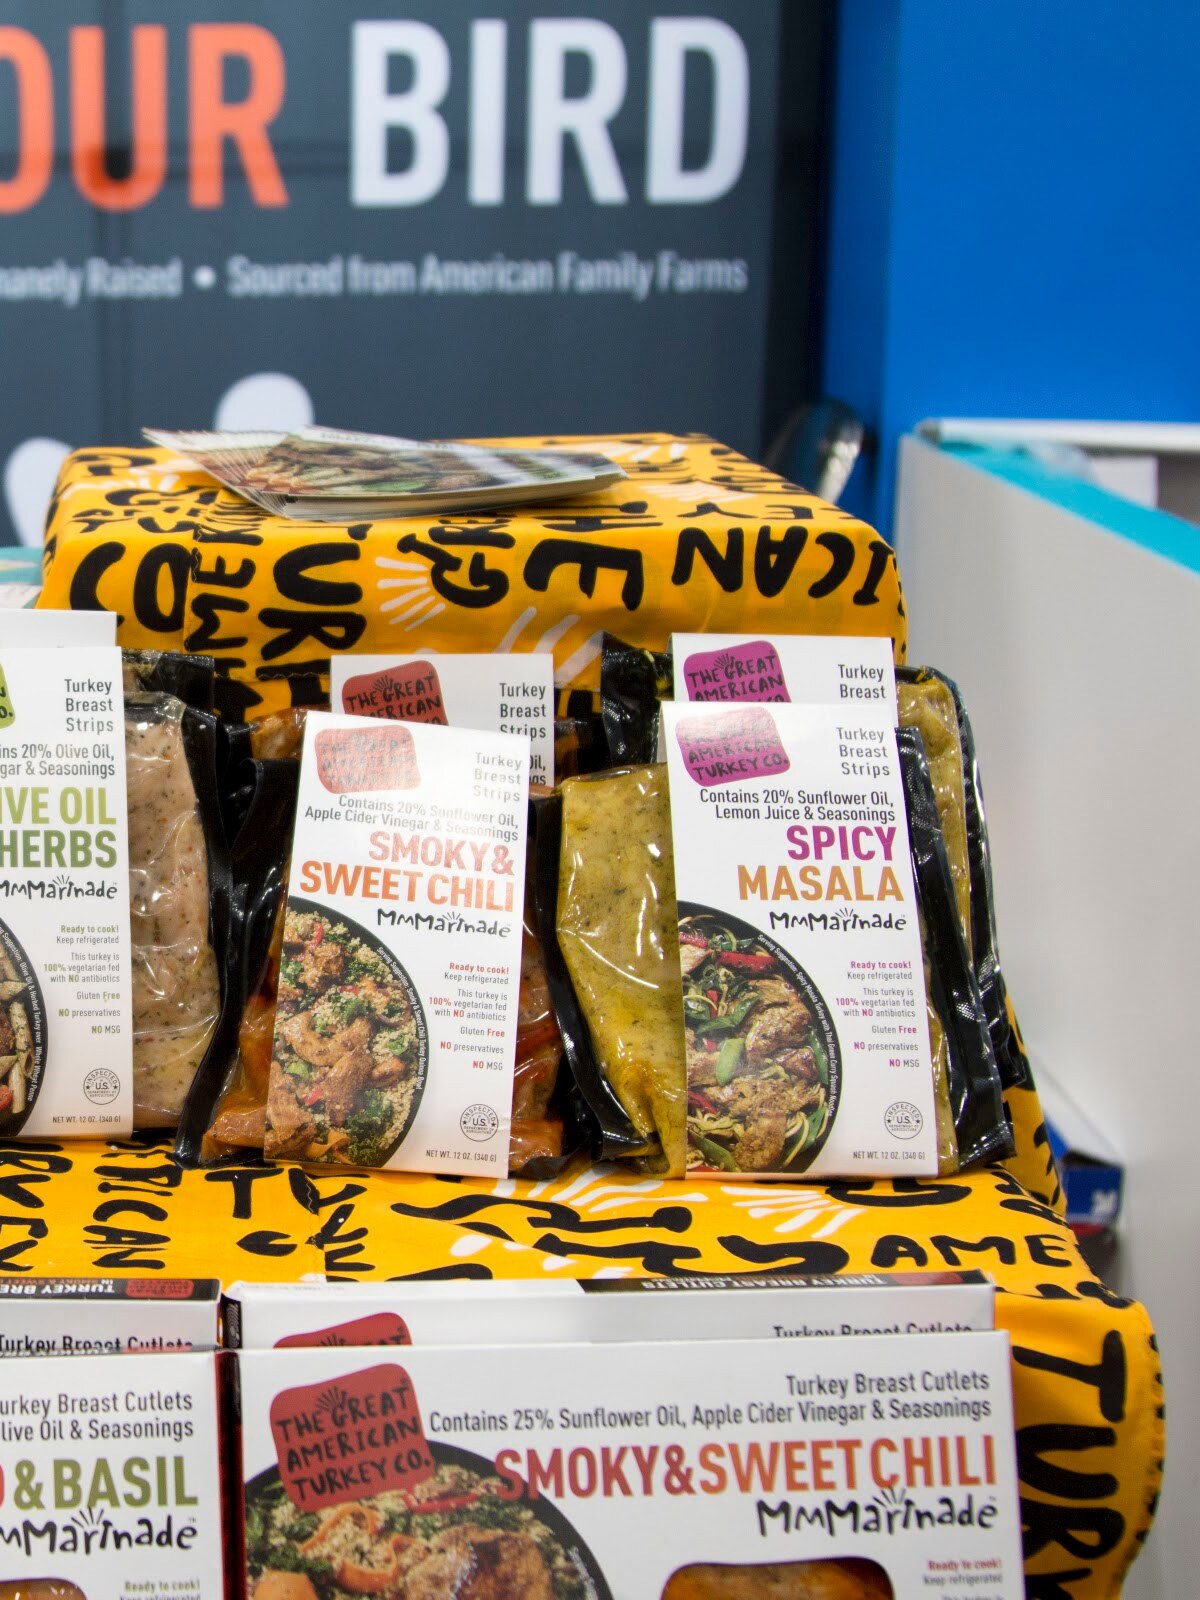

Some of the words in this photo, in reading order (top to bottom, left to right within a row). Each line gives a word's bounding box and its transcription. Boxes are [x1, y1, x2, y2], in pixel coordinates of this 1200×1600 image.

[351, 16, 751, 208] BIRD
[86, 256, 183, 299] Raised
[227, 253, 344, 297] Sourced
[349, 254, 415, 295] from
[419, 251, 553, 294] American
[558, 250, 653, 301] Family
[657, 249, 748, 294] Farms
[838, 664, 884, 682] Turkey
[64, 678, 113, 695] Turkey
[499, 682, 546, 699] Turkey
[840, 684, 887, 699] Breast
[65, 697, 113, 712] Breast
[500, 703, 546, 718] Breast
[65, 716, 114, 735] Strips
[836, 727, 884, 744] Turkey
[21, 744, 52, 759] 20%
[55, 744, 89, 759] Olive
[92, 744, 115, 761] Oil,
[839, 745, 888, 759] Breast
[25, 760, 36, 776] &
[39, 760, 116, 780] Seasonings
[841, 762, 890, 779] Strips
[59, 786, 117, 825] OIL
[338, 794, 395, 813] Contains
[700, 788, 759, 804] Contains
[762, 789, 794, 805] 20%
[797, 789, 867, 806] Sunflower
[870, 791, 894, 808] Oil,
[305, 805, 342, 822] Apple
[344, 808, 378, 825] Cider
[381, 813, 432, 831] Vinegar
[715, 804, 760, 820] Lemon
[764, 805, 800, 820] Juice
[804, 806, 814, 821] &
[818, 805, 896, 825] Seasonings
[786, 824, 897, 861] SPICY
[299, 860, 423, 902] SWEET
[427, 874, 515, 913] CHILI
[737, 864, 904, 902] MASALA
[60, 924, 86, 935] Ready
[87, 924, 96, 934] to
[97, 924, 119, 934] cook!
[56, 935, 74, 945] Keep
[76, 935, 120, 946] refrigerated
[70, 952, 87, 961] This
[88, 953, 110, 963] turkey
[111, 952, 120, 961] is
[43, 963, 66, 973] 100%
[68, 963, 107, 974] vegetarian
[108, 963, 120, 972] fed
[50, 974, 67, 983] with
[68, 974, 80, 983] NO
[81, 974, 120, 983] antibiotics
[76, 991, 101, 1001] Gluten
[102, 991, 120, 1001] Free
[58, 1008, 70, 1017] NO
[71, 1008, 121, 1019] preservatives
[91, 1025, 103, 1034] NO
[104, 1025, 121, 1034] MSG
[786, 1374, 848, 1399] Turkey
[855, 1373, 916, 1394] Breast
[922, 1371, 990, 1392] Cutlets
[58, 1393, 119, 1414] Breast
[125, 1391, 193, 1411] Cutlets
[429, 1410, 508, 1433] Contains
[513, 1409, 555, 1431] 25%
[559, 1406, 651, 1430] Sunflower
[657, 1405, 687, 1429] Oil,
[692, 1403, 742, 1431] Apple
[748, 1401, 794, 1424] Cider
[798, 1400, 866, 1427] Vinegar
[872, 1399, 884, 1420] &
[890, 1397, 992, 1422] Seasonings
[40, 1419, 64, 1441] Oil
[70, 1419, 83, 1440] &
[88, 1417, 194, 1442] Seasonings
[869, 1434, 998, 1489] CHILI
